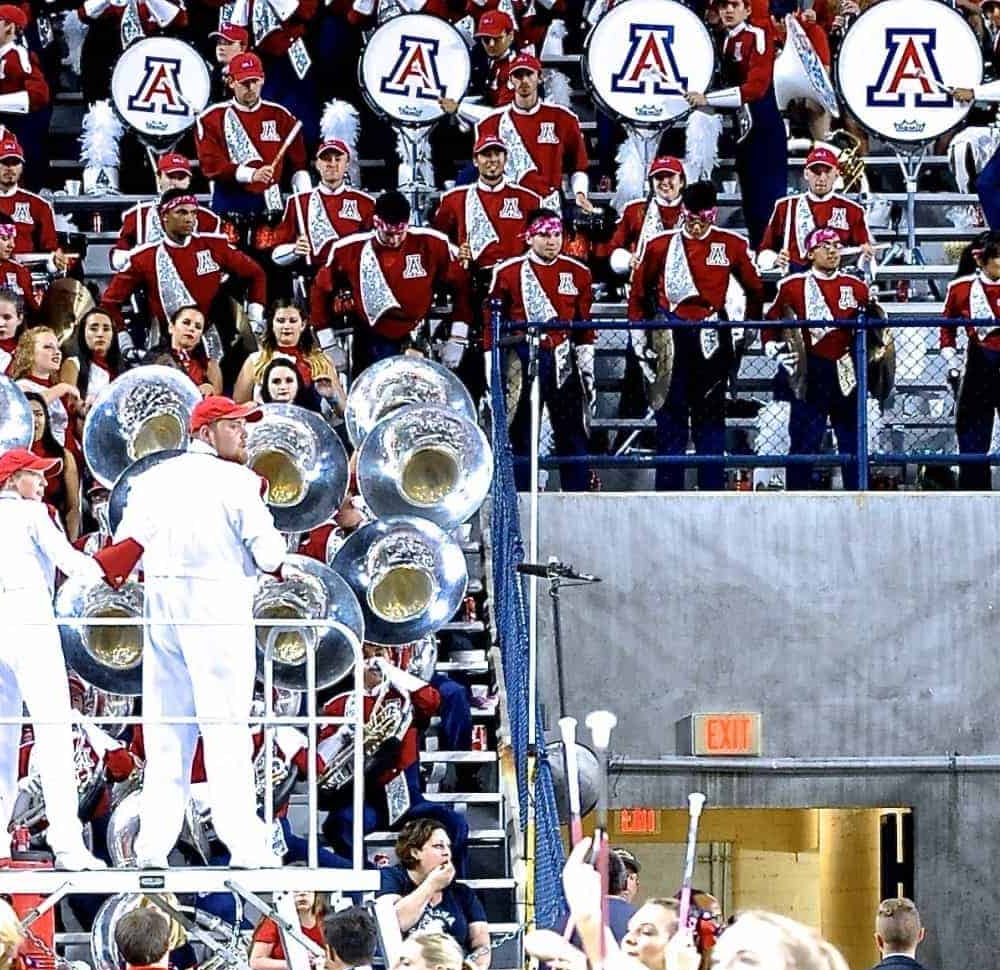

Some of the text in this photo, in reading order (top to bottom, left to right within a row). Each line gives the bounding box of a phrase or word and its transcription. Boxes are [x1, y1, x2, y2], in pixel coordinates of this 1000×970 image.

[380, 35, 447, 100] A
[611, 23, 688, 95] A
[867, 27, 954, 107] A
[128, 56, 189, 116] A
[11, 202, 34, 224] A
[339, 198, 362, 221] A
[500, 197, 523, 219] A
[196, 250, 220, 275] A
[403, 253, 428, 279] A
[706, 243, 730, 266] A
[557, 271, 578, 295] A
[707, 718, 751, 751] EXIT
